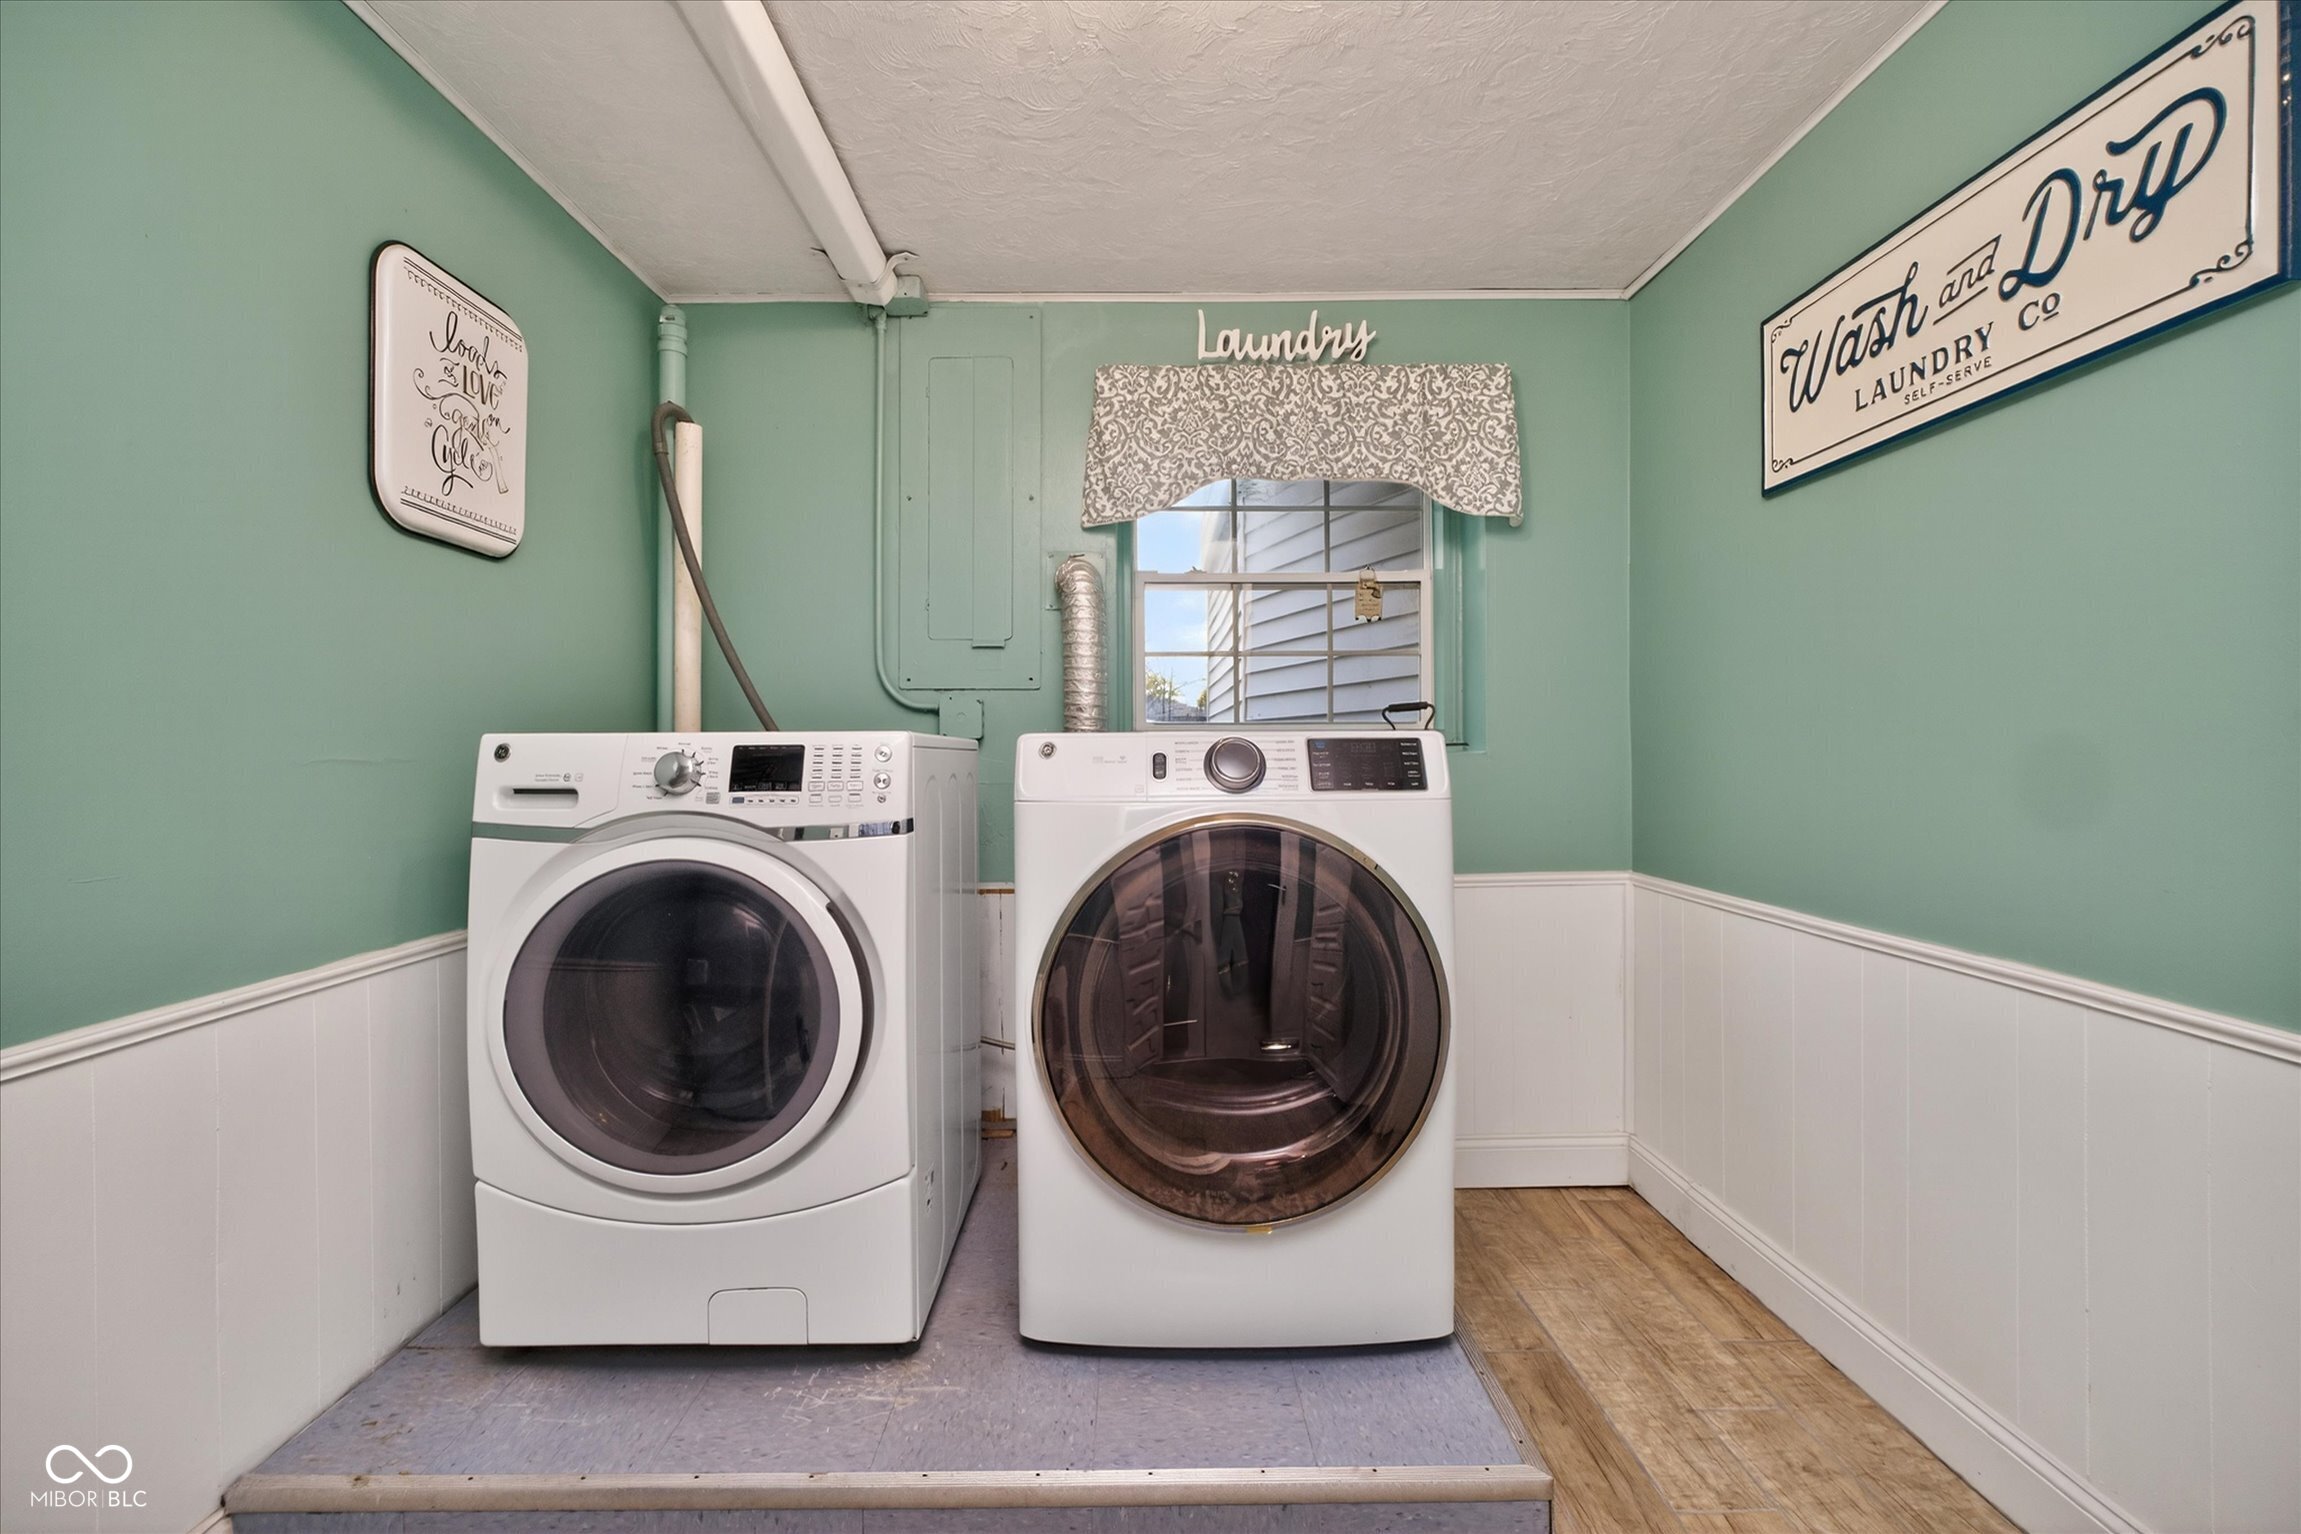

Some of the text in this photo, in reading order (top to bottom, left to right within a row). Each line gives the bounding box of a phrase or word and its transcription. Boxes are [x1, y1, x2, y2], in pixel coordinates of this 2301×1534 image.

[1779, 86, 2228, 413] Wash and Dry
[1198, 308, 1377, 362] Laundry
[1854, 320, 1995, 412] LAUNDRY
[1903, 355, 1993, 406] SELF-SERVE
